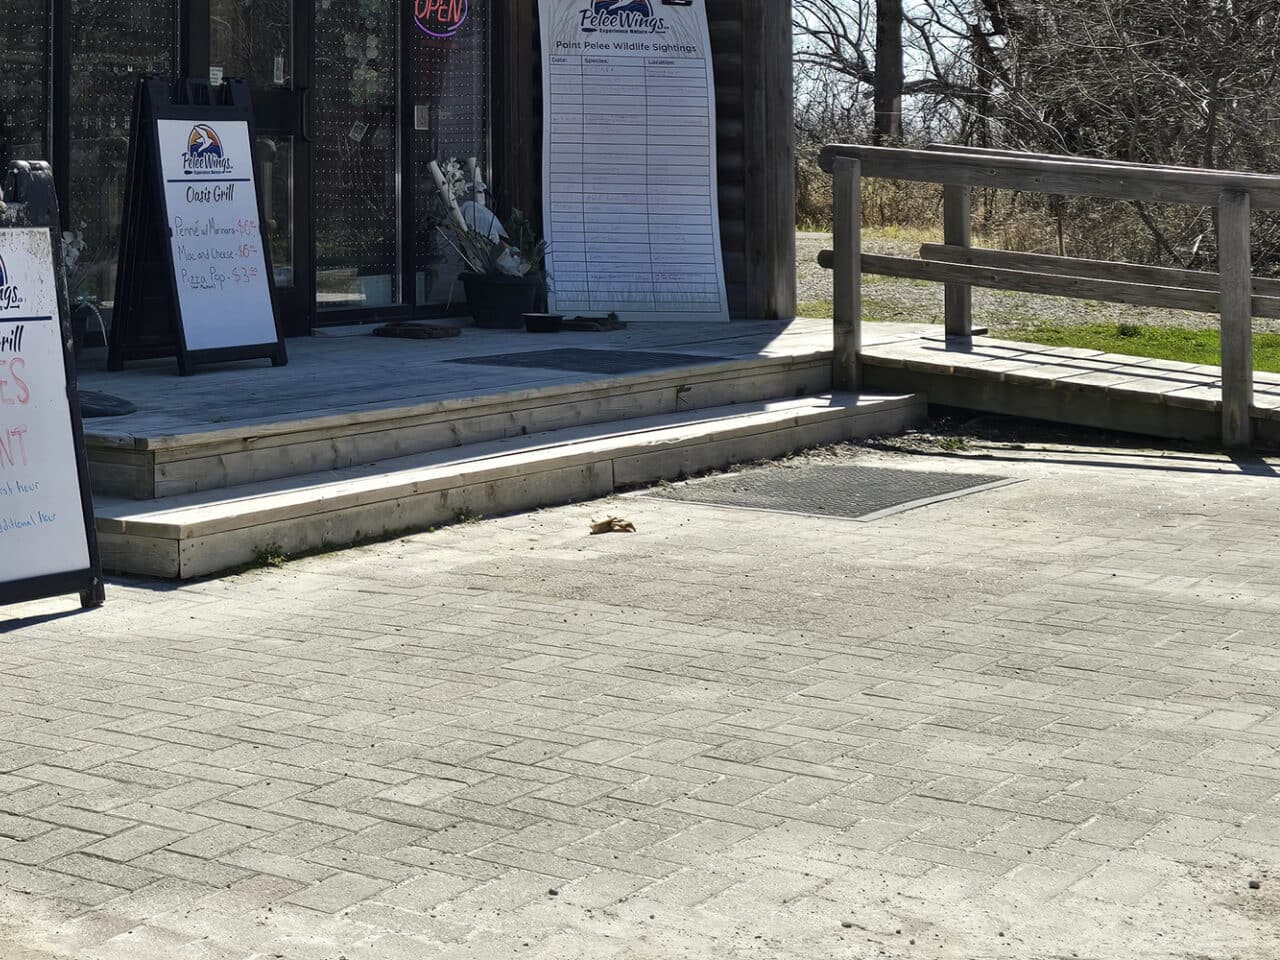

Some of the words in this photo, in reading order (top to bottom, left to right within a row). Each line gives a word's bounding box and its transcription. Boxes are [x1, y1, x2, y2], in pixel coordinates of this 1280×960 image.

[555, 40, 581, 50] Point
[583, 41, 611, 50] Pelee
[613, 41, 650, 51] Wildlife
[652, 43, 697, 53] Sightings
[186, 185, 211, 203] Oasis
[213, 183, 235, 202] Grill
[177, 244, 197, 261] Mac
[197, 248, 210, 260] and
